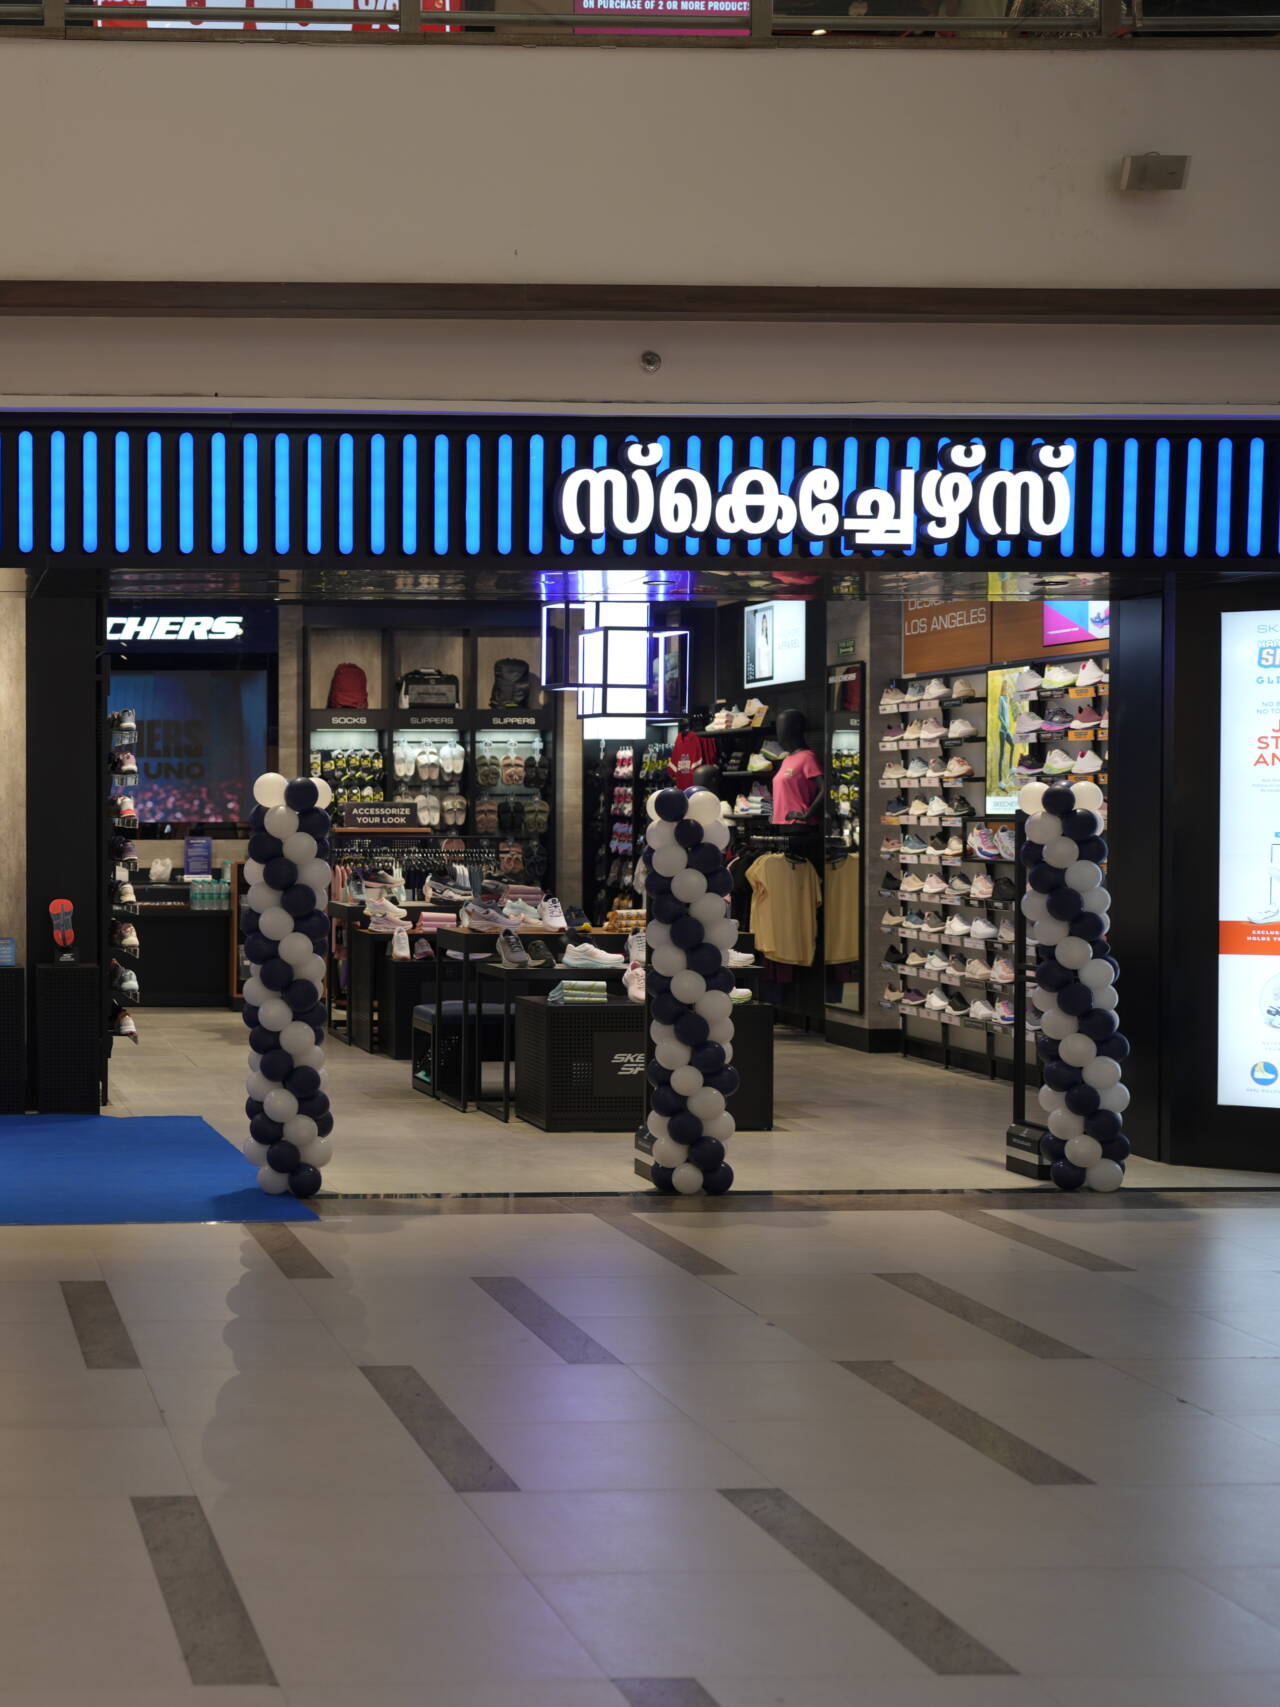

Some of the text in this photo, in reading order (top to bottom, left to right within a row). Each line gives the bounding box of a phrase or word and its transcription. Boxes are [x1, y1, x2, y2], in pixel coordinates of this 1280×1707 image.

[583, 0, 595, 8] ON
[598, 0, 641, 9] PURCHASE
[644, 0, 655, 9] OF
[658, 1, 663, 9] 2
[666, 1, 677, 9] OR
[681, 1, 705, 10] MORE
[905, 607, 987, 635] LOS ANGELES
[331, 716, 368, 725] SOCKS
[410, 717, 454, 725] SLIPPERS
[491, 717, 536, 725] SLIPPERS
[144, 761, 205, 779] UNO
[352, 807, 411, 815] ACCESSORIZE
[356, 816, 407, 824] YOUR LOOK
